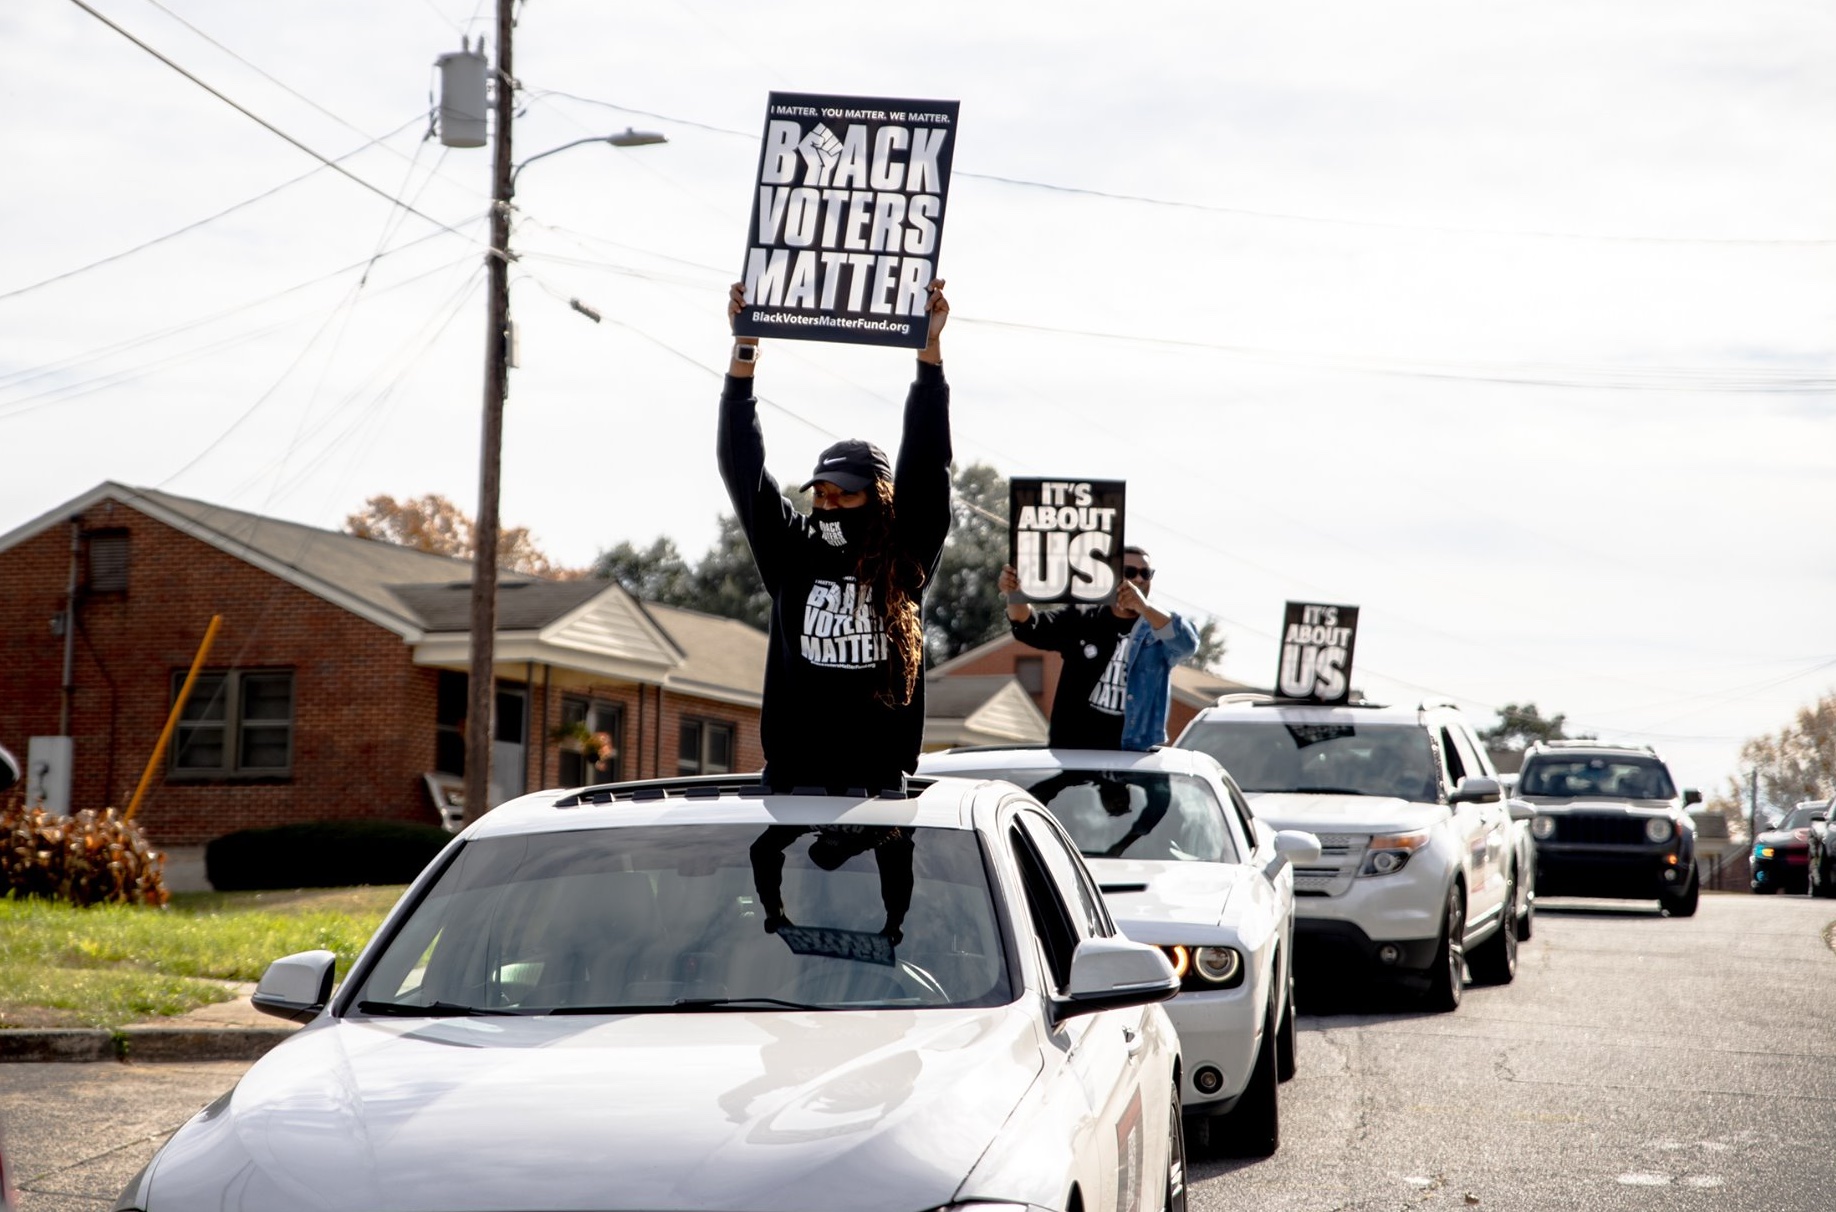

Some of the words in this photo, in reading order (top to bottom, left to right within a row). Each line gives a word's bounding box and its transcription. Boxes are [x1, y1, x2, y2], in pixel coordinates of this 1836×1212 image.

[770, 105, 775, 114] I
[776, 106, 818, 116] MATTER.
[821, 108, 843, 117] YOU
[845, 109, 887, 119] MATTER.
[889, 112, 906, 120] WE
[908, 113, 951, 123] MATTER.
[761, 119, 947, 194] BACK
[759, 185, 941, 255] VOTERS
[744, 247, 934, 317] MATTER
[752, 311, 910, 335] BlackVotersMatterFund.org
[1040, 481, 1093, 507] IT'S
[1017, 505, 1117, 532] ABOUT
[1016, 530, 1116, 600] US
[1302, 604, 1339, 626] IT'S
[1284, 623, 1352, 648] ABOUT
[1279, 643, 1347, 700] US
